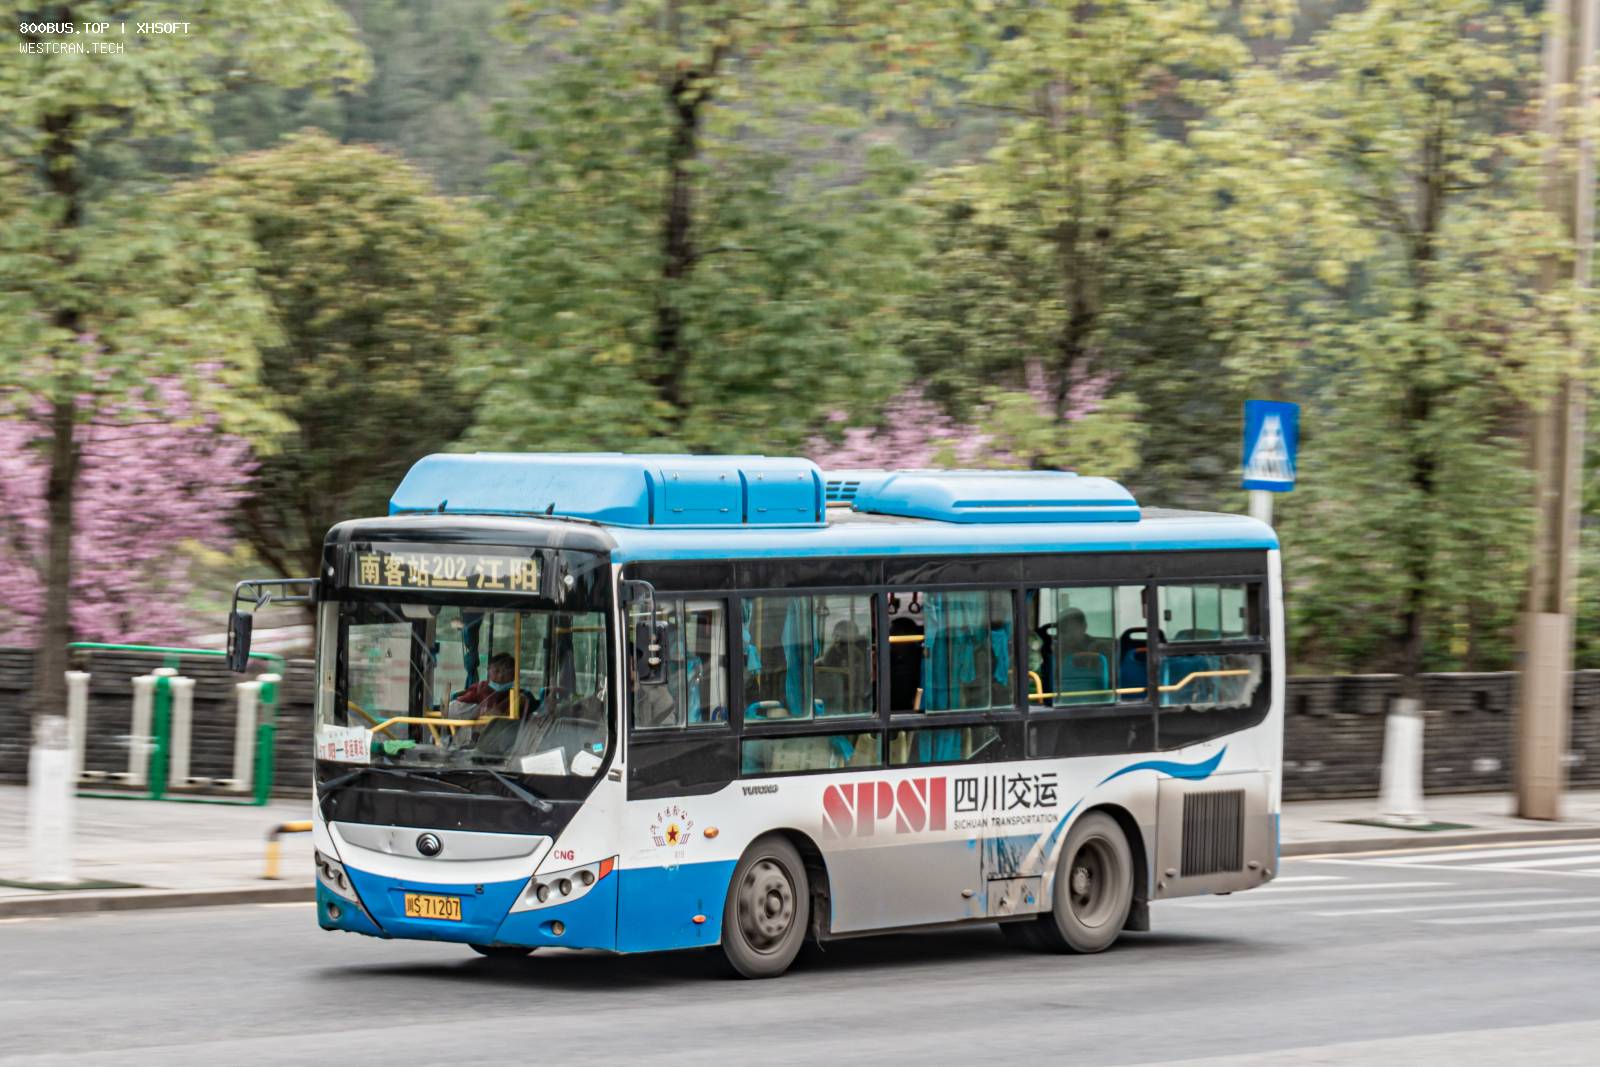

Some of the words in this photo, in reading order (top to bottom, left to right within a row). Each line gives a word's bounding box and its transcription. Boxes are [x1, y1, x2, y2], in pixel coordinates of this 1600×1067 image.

[359, 553, 429, 587] 南客站
[433, 556, 467, 580] 202
[475, 557, 538, 591] 江阳
[822, 776, 947, 839] SPSI
[954, 772, 1058, 812] 四川交运
[953, 818, 988, 831] SICHUAN
[991, 813, 1059, 828] TRANSPORTATION
[554, 850, 575, 861] CNG
